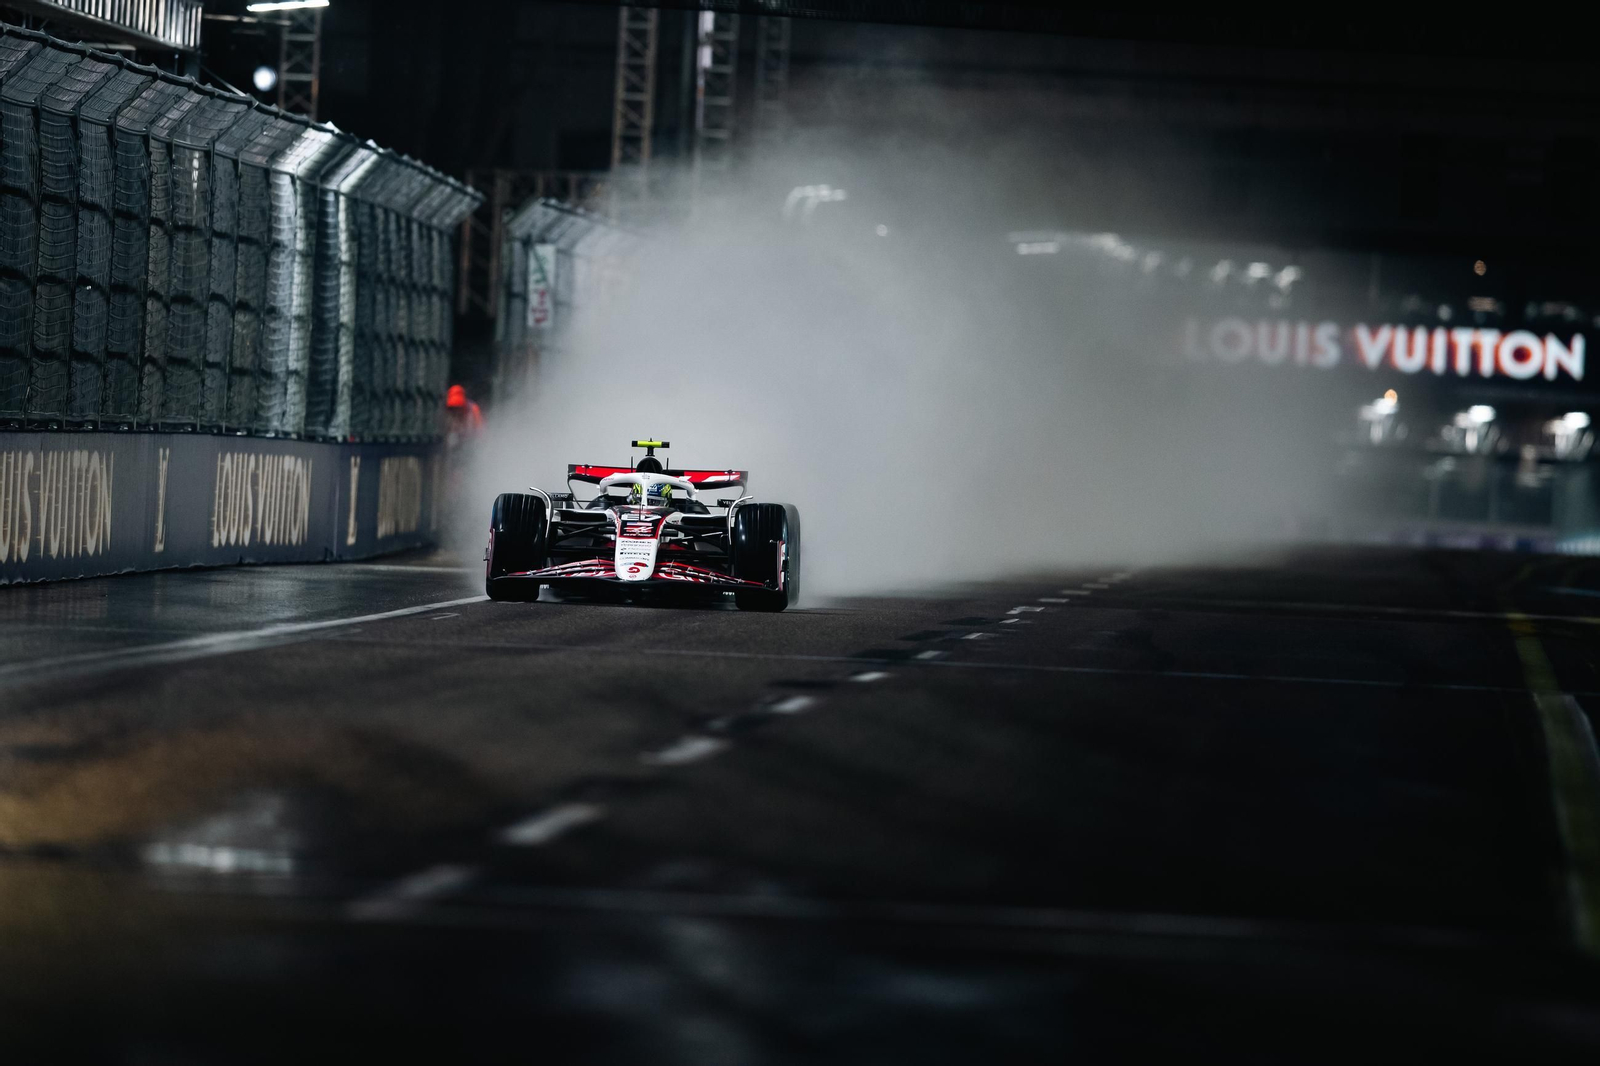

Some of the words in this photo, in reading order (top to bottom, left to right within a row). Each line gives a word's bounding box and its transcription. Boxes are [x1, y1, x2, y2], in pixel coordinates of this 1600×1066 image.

[1184, 317, 1341, 370] LOUIS
[1354, 322, 1586, 382] VUITTON
[40, 449, 114, 560] VUITTON
[212, 451, 256, 548] LOUIS
[257, 452, 312, 546] VUITTON
